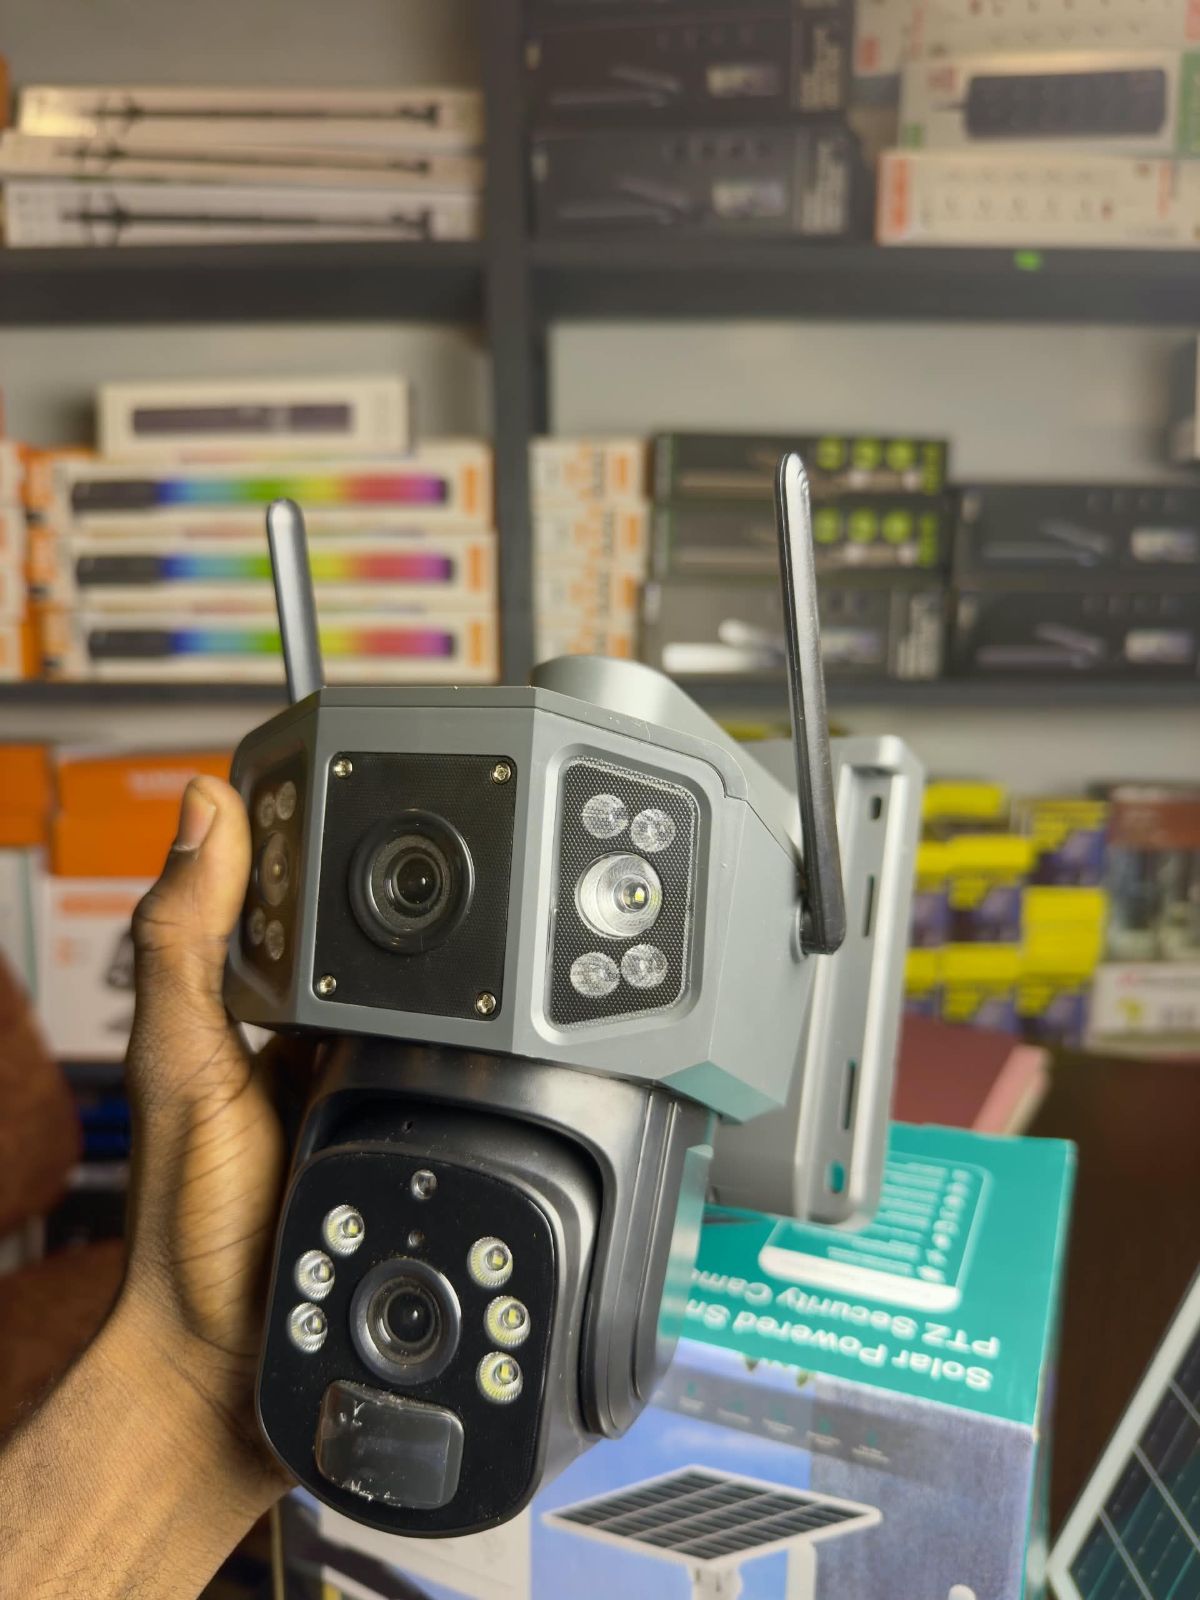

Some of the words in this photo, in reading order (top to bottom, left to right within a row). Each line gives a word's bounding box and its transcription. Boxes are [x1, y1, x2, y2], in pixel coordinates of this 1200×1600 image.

[776, 1287, 919, 1341] Security
[732, 1311, 888, 1368] Powered
[921, 1322, 1000, 1359] PTZ
[891, 1350, 994, 1391] Solar
